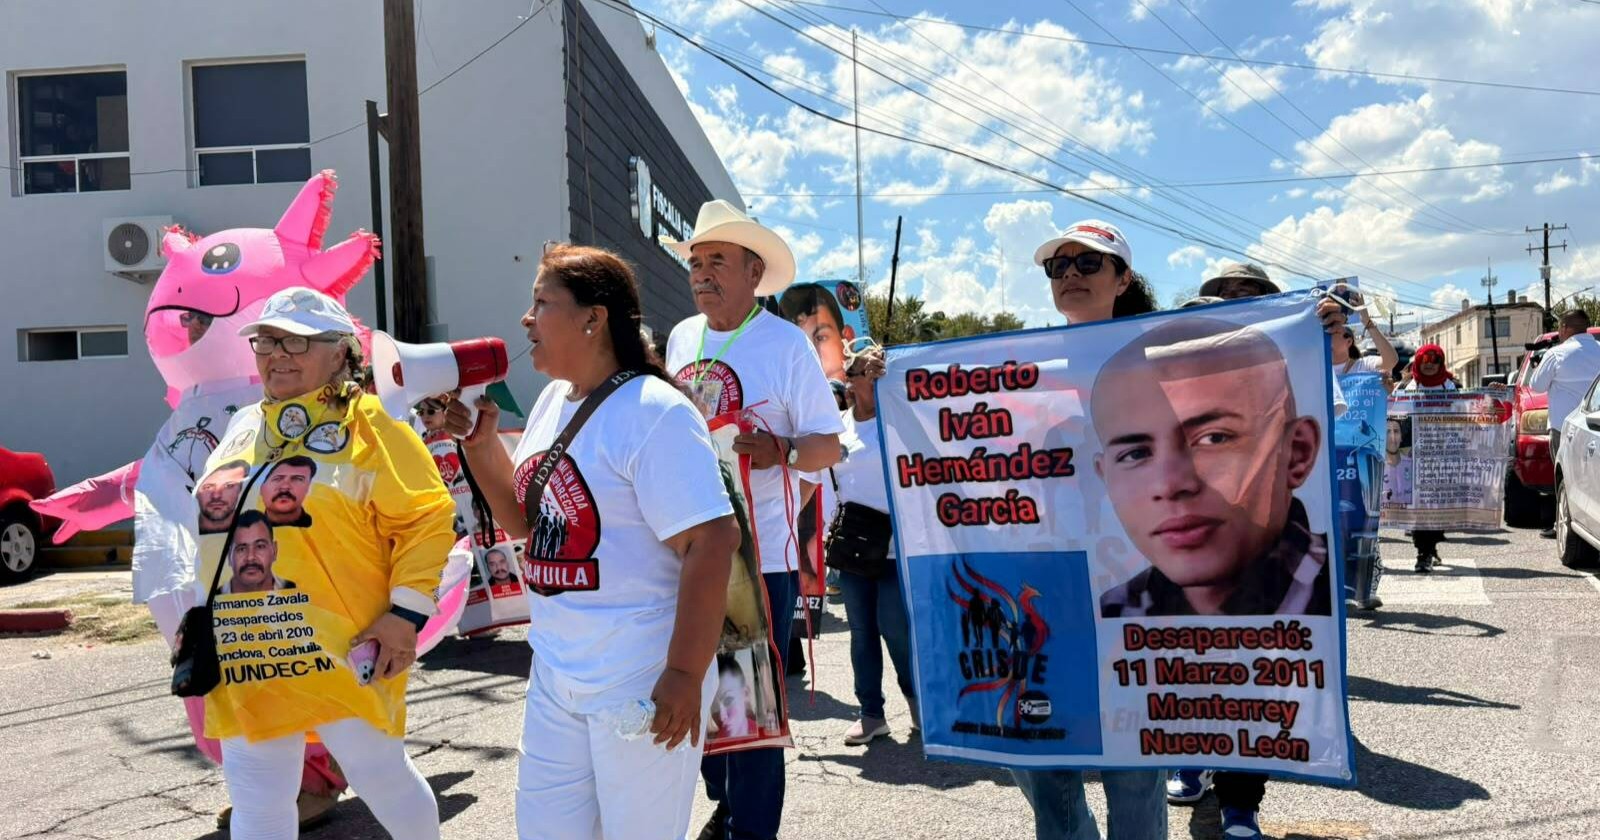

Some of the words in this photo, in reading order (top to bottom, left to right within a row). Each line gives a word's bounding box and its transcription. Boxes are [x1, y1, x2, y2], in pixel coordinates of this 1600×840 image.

[906, 360, 1038, 401] Roberto
[939, 405, 1011, 442] Iván
[534, 442, 564, 487] COACH
[898, 443, 1074, 488] Hernández
[1336, 467, 1357, 480] 28
[568, 483, 588, 510] VIDA
[937, 491, 1039, 527] García
[212, 596, 265, 611] ermanos
[266, 592, 309, 606] Zavala
[213, 611, 303, 628] Desaparecidos
[221, 631, 238, 645] 23
[240, 630, 255, 642] de
[258, 628, 284, 641] abril
[286, 626, 314, 640] 2010
[218, 648, 266, 663] onclova,
[268, 641, 323, 658] Coahuila
[1123, 620, 1313, 653] Desapareció:
[1113, 660, 1147, 687] 11
[1155, 658, 1248, 687] Marzo
[1253, 658, 1325, 689] 2011
[1147, 693, 1299, 727] Monterrey
[1141, 729, 1234, 757] Nuevo
[1238, 729, 1310, 762] León
